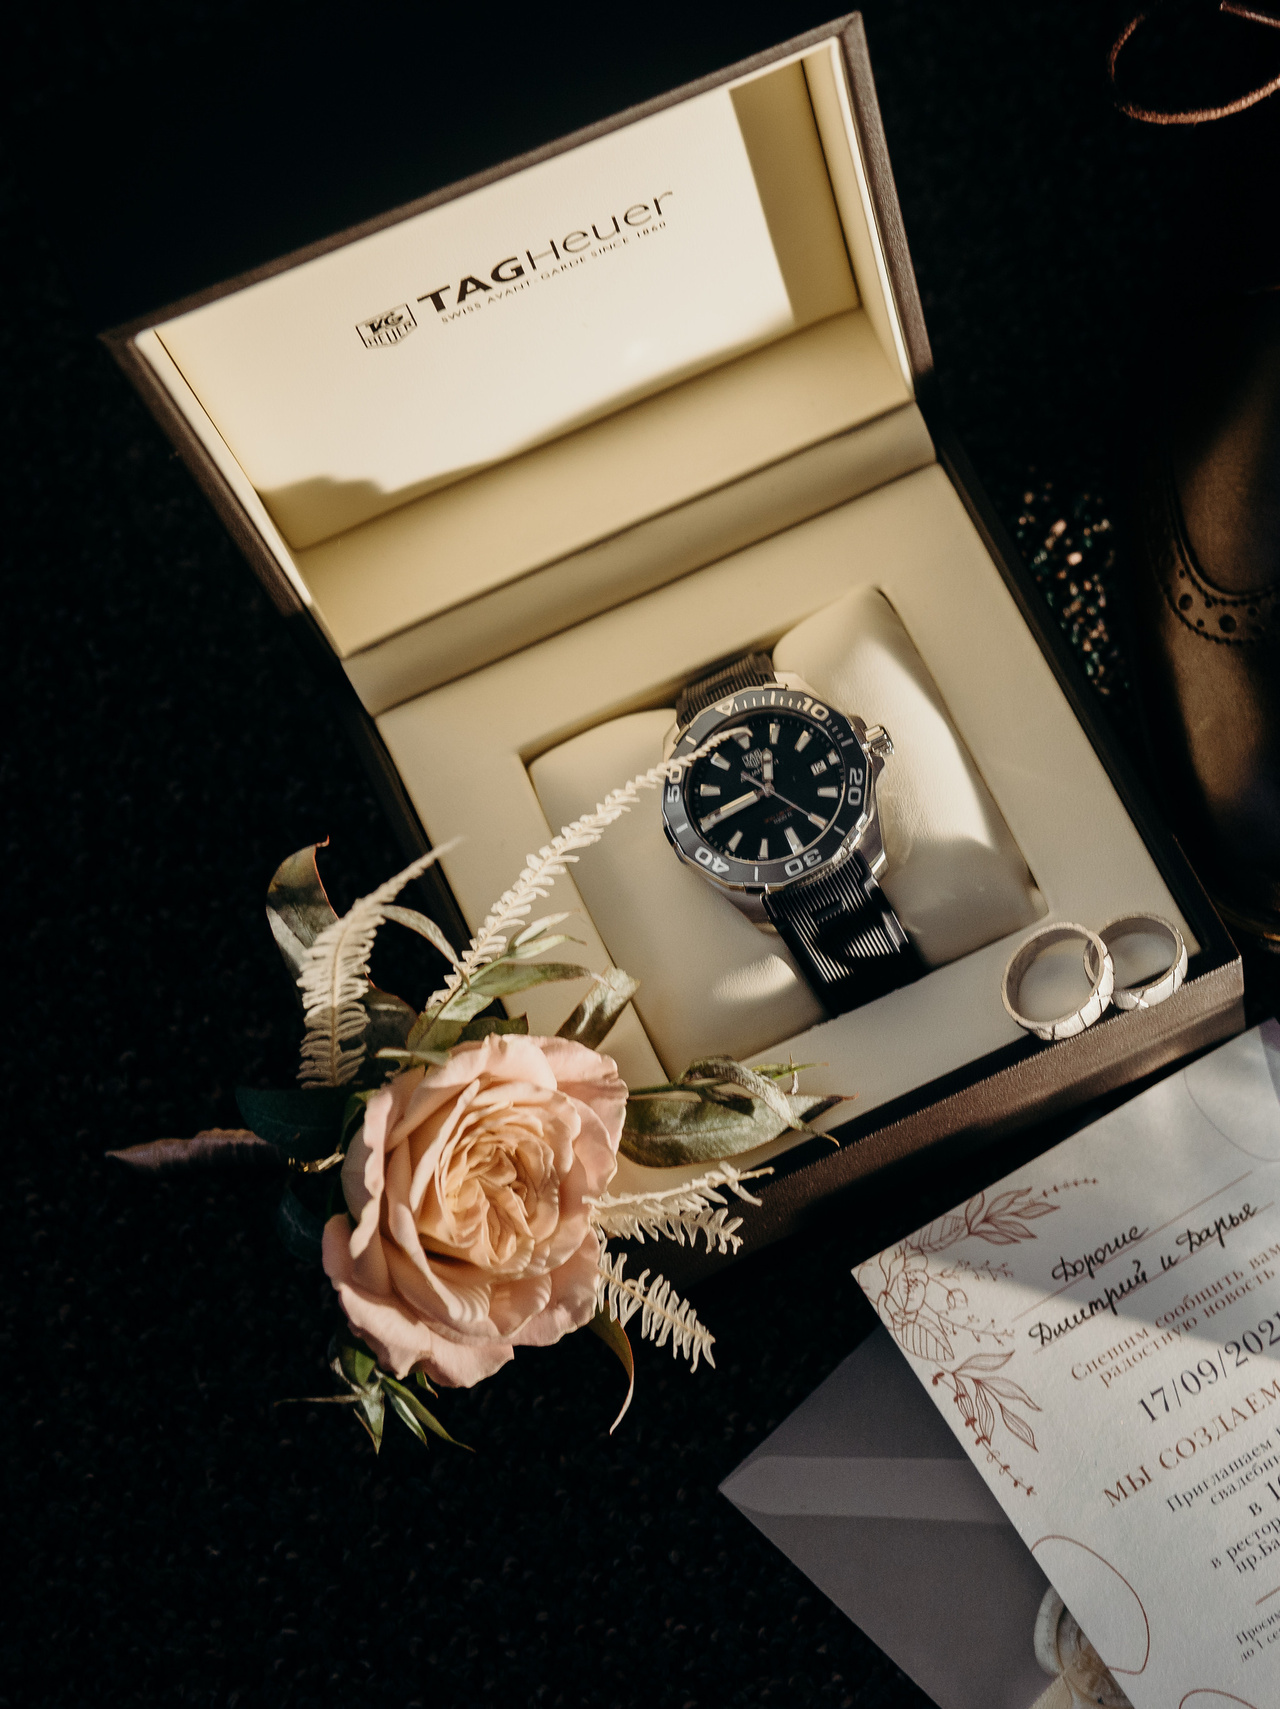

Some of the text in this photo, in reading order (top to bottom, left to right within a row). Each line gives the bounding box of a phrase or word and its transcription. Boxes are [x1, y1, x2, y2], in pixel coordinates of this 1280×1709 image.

[442, 303, 481, 323] SWISS
[591, 237, 629, 258] SINCE
[636, 221, 667, 238] 1860
[803, 697, 829, 722] 10
[848, 767, 864, 806] 20
[694, 846, 730, 874] 40
[784, 848, 822, 877] 30
[1029, 1203, 1258, 1346] Дмитрий и Дарья
[1051, 1226, 1149, 1282] Дорогие
[1071, 1327, 1150, 1381] Спешим
[1155, 1269, 1245, 1329] сообщить
[1099, 1269, 1276, 1389] радостную новость
[1104, 1465, 1154, 1508] МЫ
[1166, 1440, 1273, 1513] Приглашаем
[1248, 1501, 1263, 1517] в
[1211, 1557, 1223, 1570] в
[1239, 1648, 1255, 1664] до
